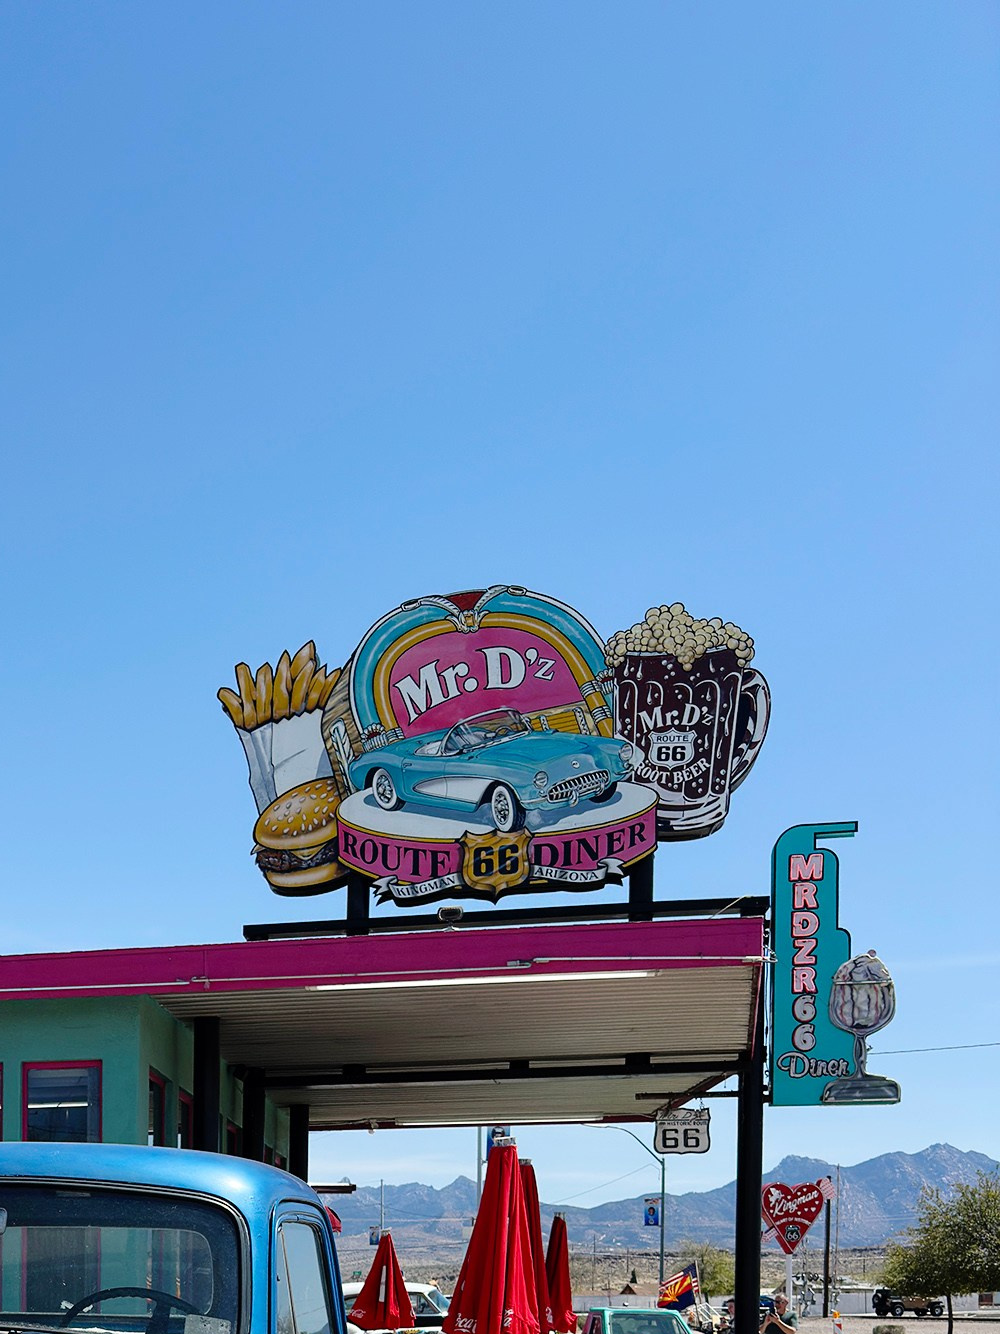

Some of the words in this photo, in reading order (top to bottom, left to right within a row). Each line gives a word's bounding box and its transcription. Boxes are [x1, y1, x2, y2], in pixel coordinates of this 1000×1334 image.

[475, 646, 556, 690] D'z
[656, 735, 689, 743] ROUTE
[656, 745, 686, 762] 66
[635, 761, 670, 784] ROOT
[673, 758, 711, 784] BEER
[342, 831, 451, 878] ROUTE
[473, 846, 519, 877] 66
[533, 822, 648, 868] DINER
[396, 875, 456, 896] KINGMAN
[534, 866, 599, 881] ARIZONA
[777, 1051, 849, 1078] Diner
[662, 1129, 700, 1148] 66
[773, 1190, 819, 1217] Kingman
[787, 1232, 799, 1240] 66
